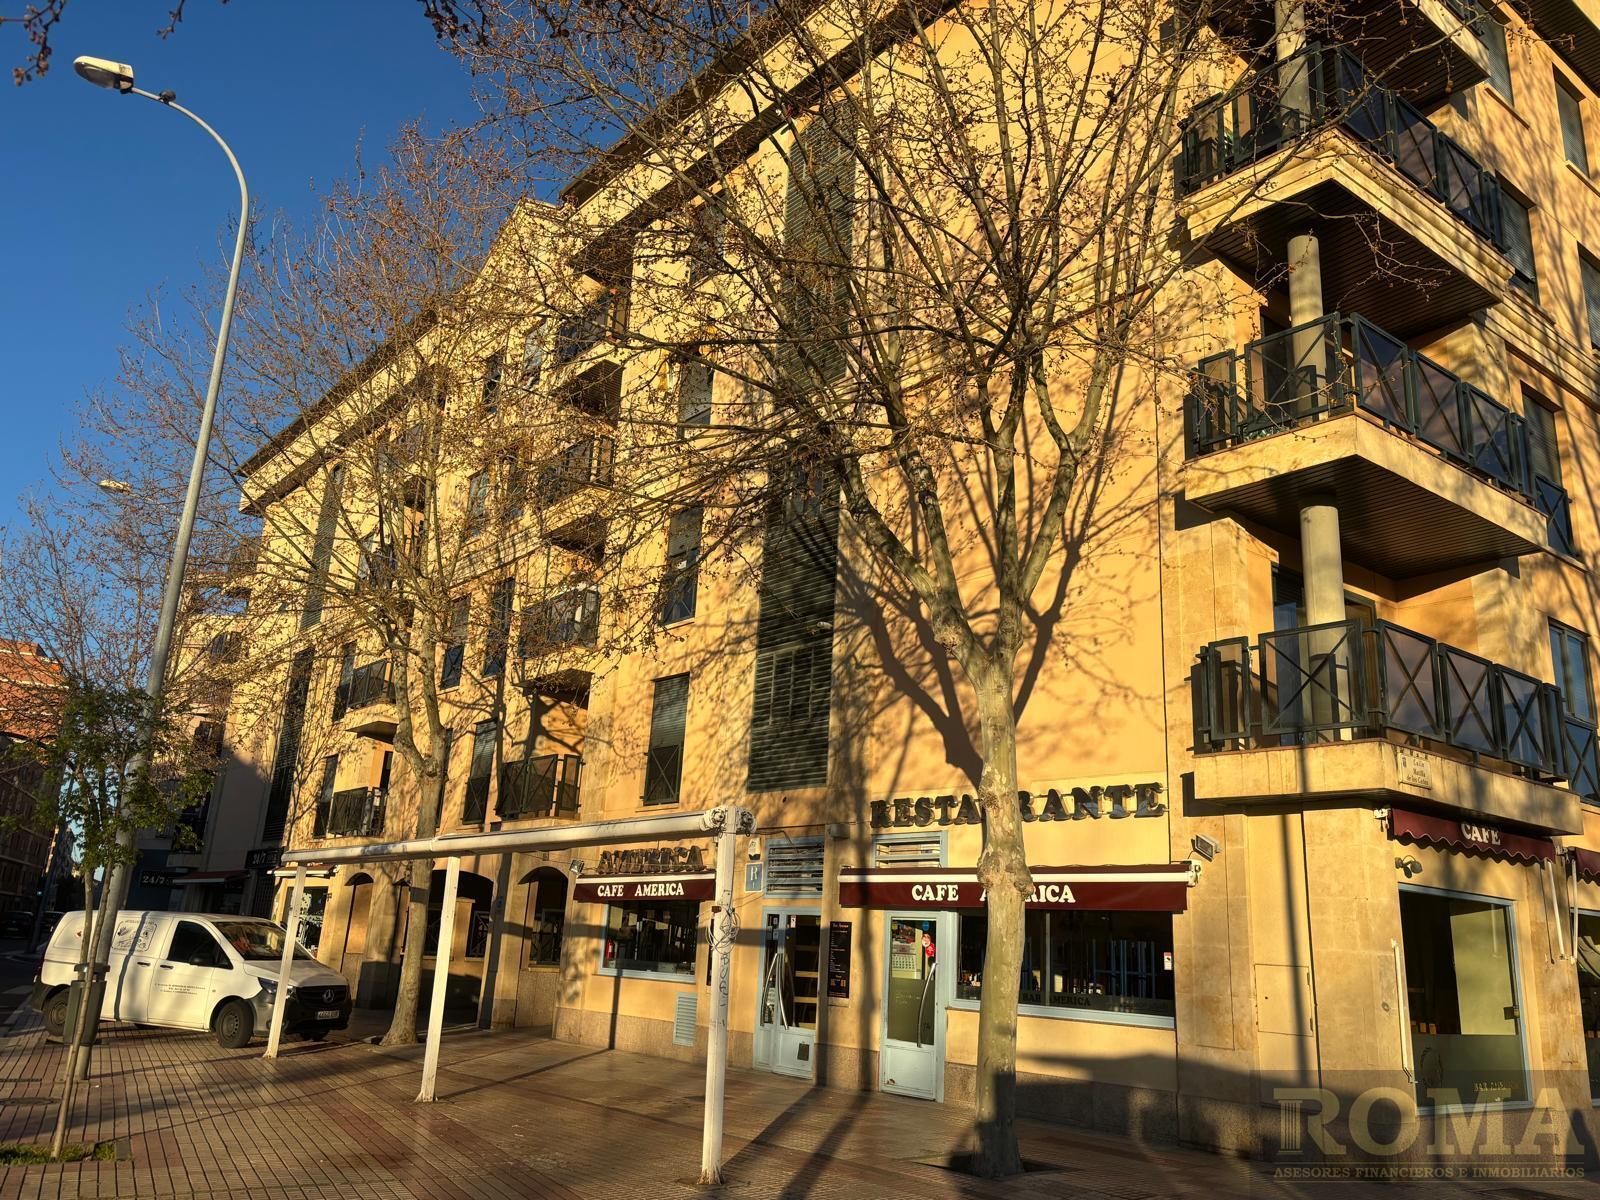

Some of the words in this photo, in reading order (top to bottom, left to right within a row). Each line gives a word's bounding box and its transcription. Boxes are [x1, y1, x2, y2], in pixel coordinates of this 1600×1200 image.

[870, 782, 1169, 828] RESTARANTE
[1461, 822, 1501, 846] CAFE
[142, 874, 165, 885] 24/7
[597, 884, 624, 897] CAFE
[634, 882, 685, 897] AMERICA
[911, 884, 959, 902] CAFE
[979, 884, 1076, 903] RICA
